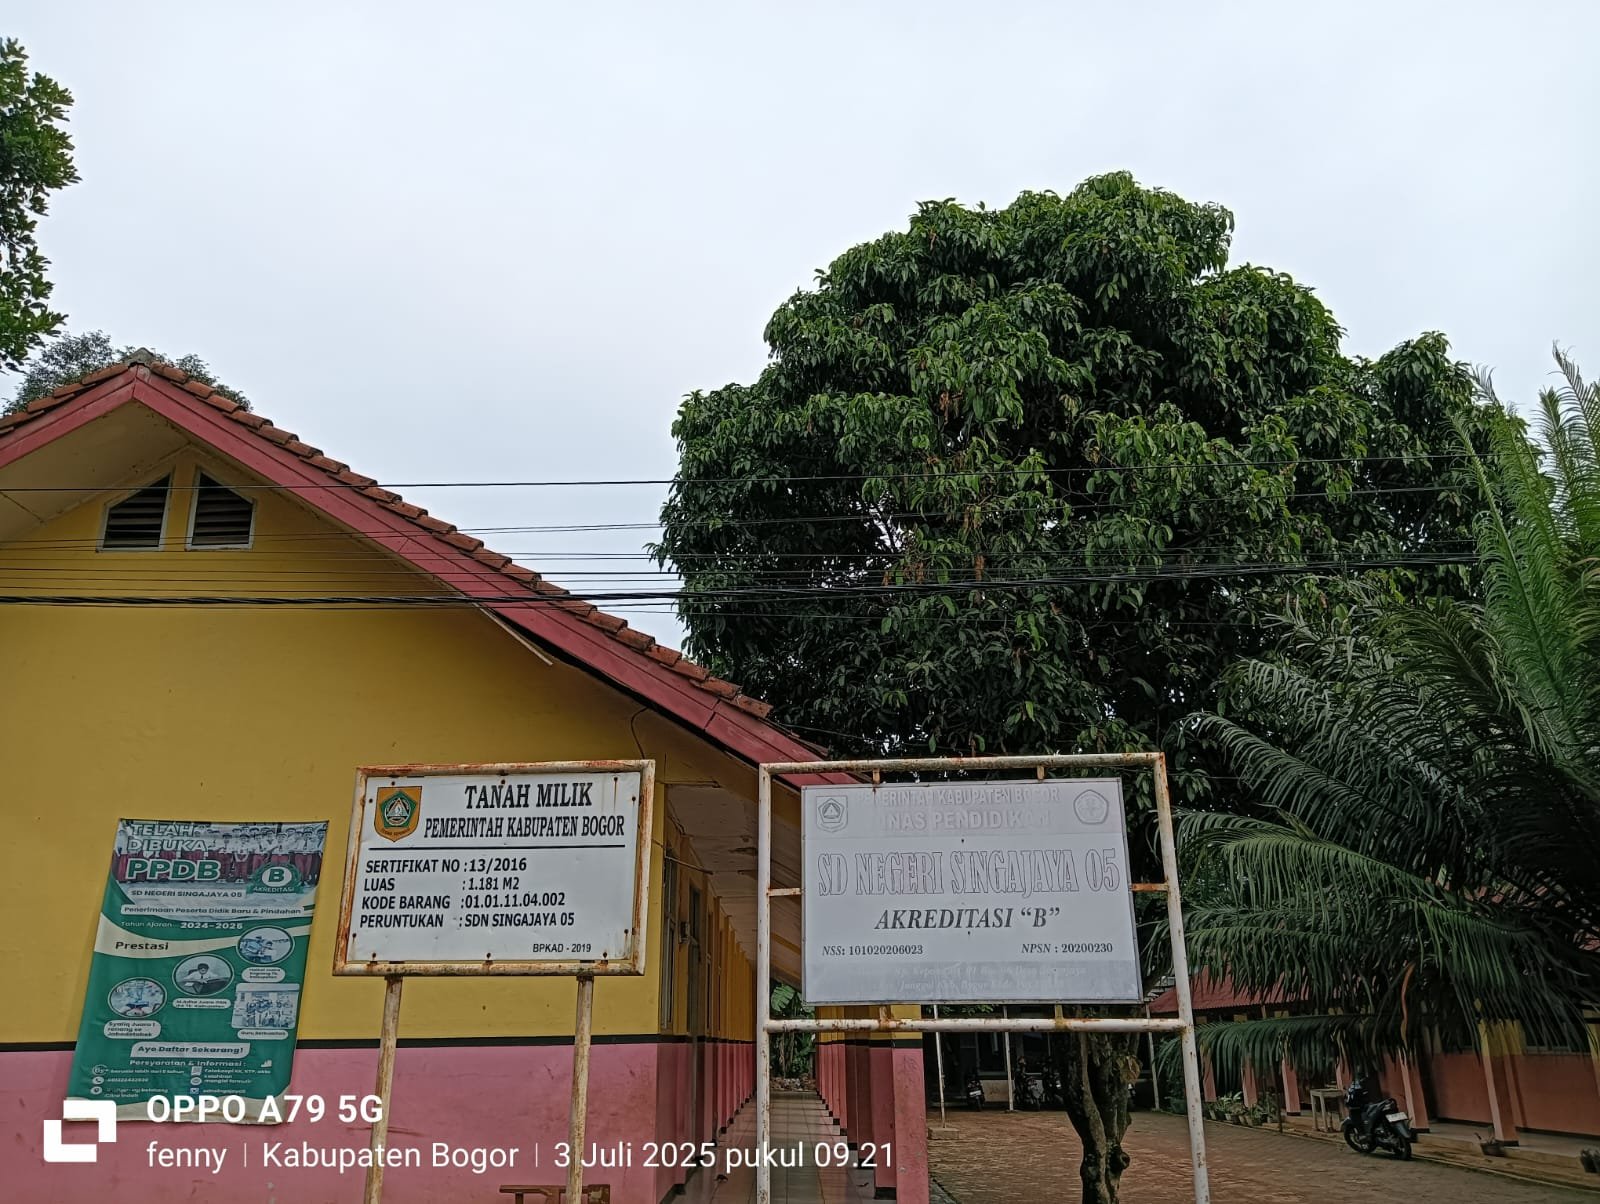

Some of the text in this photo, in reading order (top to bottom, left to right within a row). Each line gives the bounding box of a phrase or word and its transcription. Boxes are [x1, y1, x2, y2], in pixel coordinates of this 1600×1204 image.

[464, 781, 594, 810] TANAH MILIK
[938, 788, 1013, 806] KABUPATEN
[1014, 786, 1063, 804] BOGOR
[131, 824, 195, 837] TELAH
[423, 816, 504, 839] PEMERINTAH
[506, 815, 579, 838] KABUPATEN
[581, 814, 626, 837] BOGOR
[127, 839, 208, 852] DIBUKA
[125, 858, 222, 881] PPDB
[365, 859, 439, 874] SERTIFIKAT
[441, 859, 461, 873] NO
[816, 847, 1121, 899] SD NEGERI SINGAJAYA 05
[267, 868, 286, 883] B
[252, 886, 296, 894] AKREDITASI
[363, 878, 396, 892] LUAS
[503, 877, 520, 890] M2
[145, 890, 176, 898] NEGERI
[177, 890, 229, 898] SINGAJAYA
[361, 896, 396, 910] KODE
[398, 895, 451, 910] BARANG
[359, 913, 444, 928] PERUNTUKAN
[491, 912, 557, 927] SINGAJAYA
[560, 911, 575, 926] 05
[874, 907, 1014, 931] AKREDITASI
[115, 941, 169, 951] Prestasi
[532, 943, 564, 953] BPKAD
[571, 942, 592, 953] 2019
[822, 944, 924, 957] NSS: 101020206023
[1021, 943, 1052, 954] NPSN
[1061, 942, 1114, 953] 20200230
[137, 1045, 244, 1055] Ayo Daftar Sekarang!
[129, 1060, 186, 1068] Persyaratan
